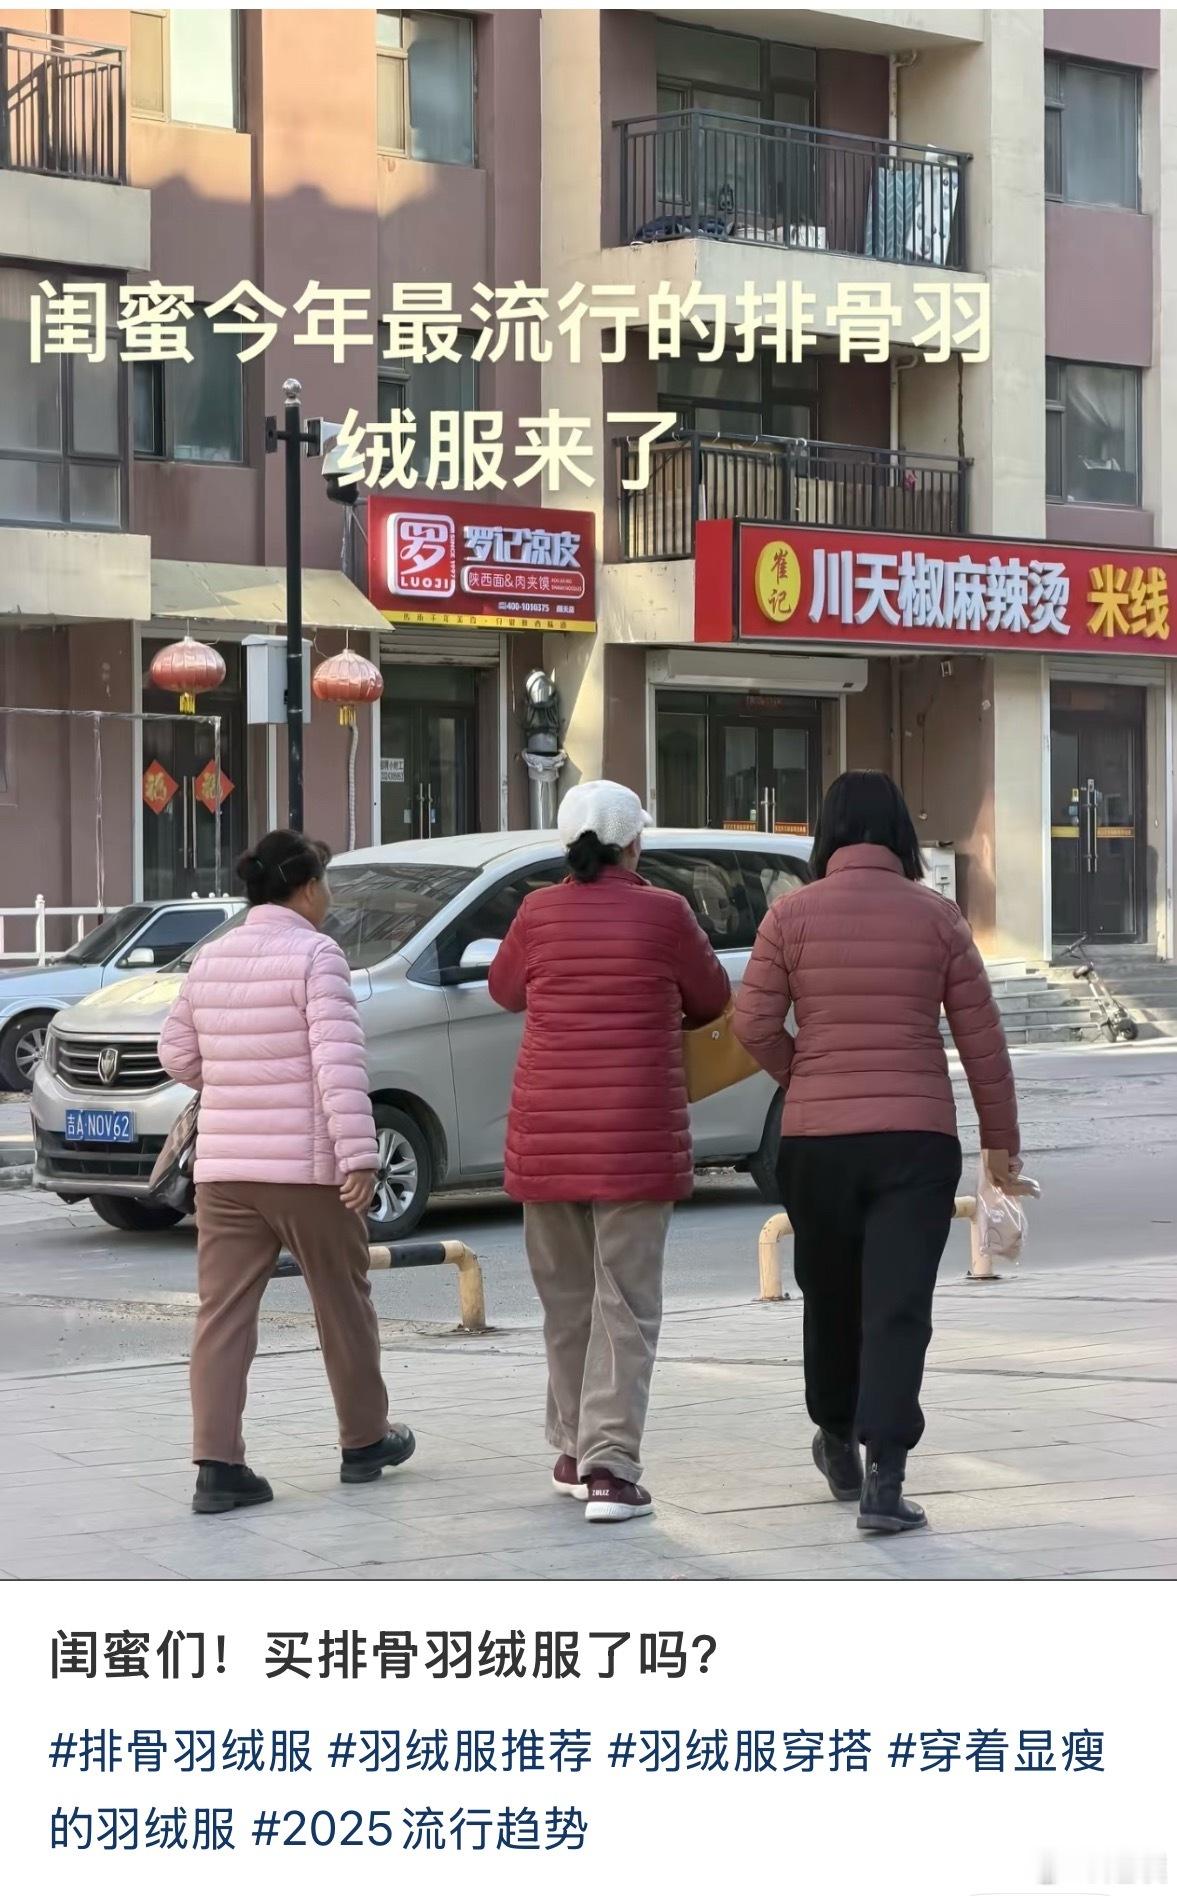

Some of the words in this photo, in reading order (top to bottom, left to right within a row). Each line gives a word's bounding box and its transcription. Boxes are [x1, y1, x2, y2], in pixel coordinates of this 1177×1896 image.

[401, 521, 449, 575] 罗
[464, 525, 580, 567] 罗记凉皮
[401, 577, 449, 589] LUOJI
[469, 572, 551, 592] 陕西面&肉夹馍
[768, 548, 792, 614] 崔记
[808, 548, 1071, 636] 川天椒麻辣烫
[1086, 564, 1170, 640] 米线
